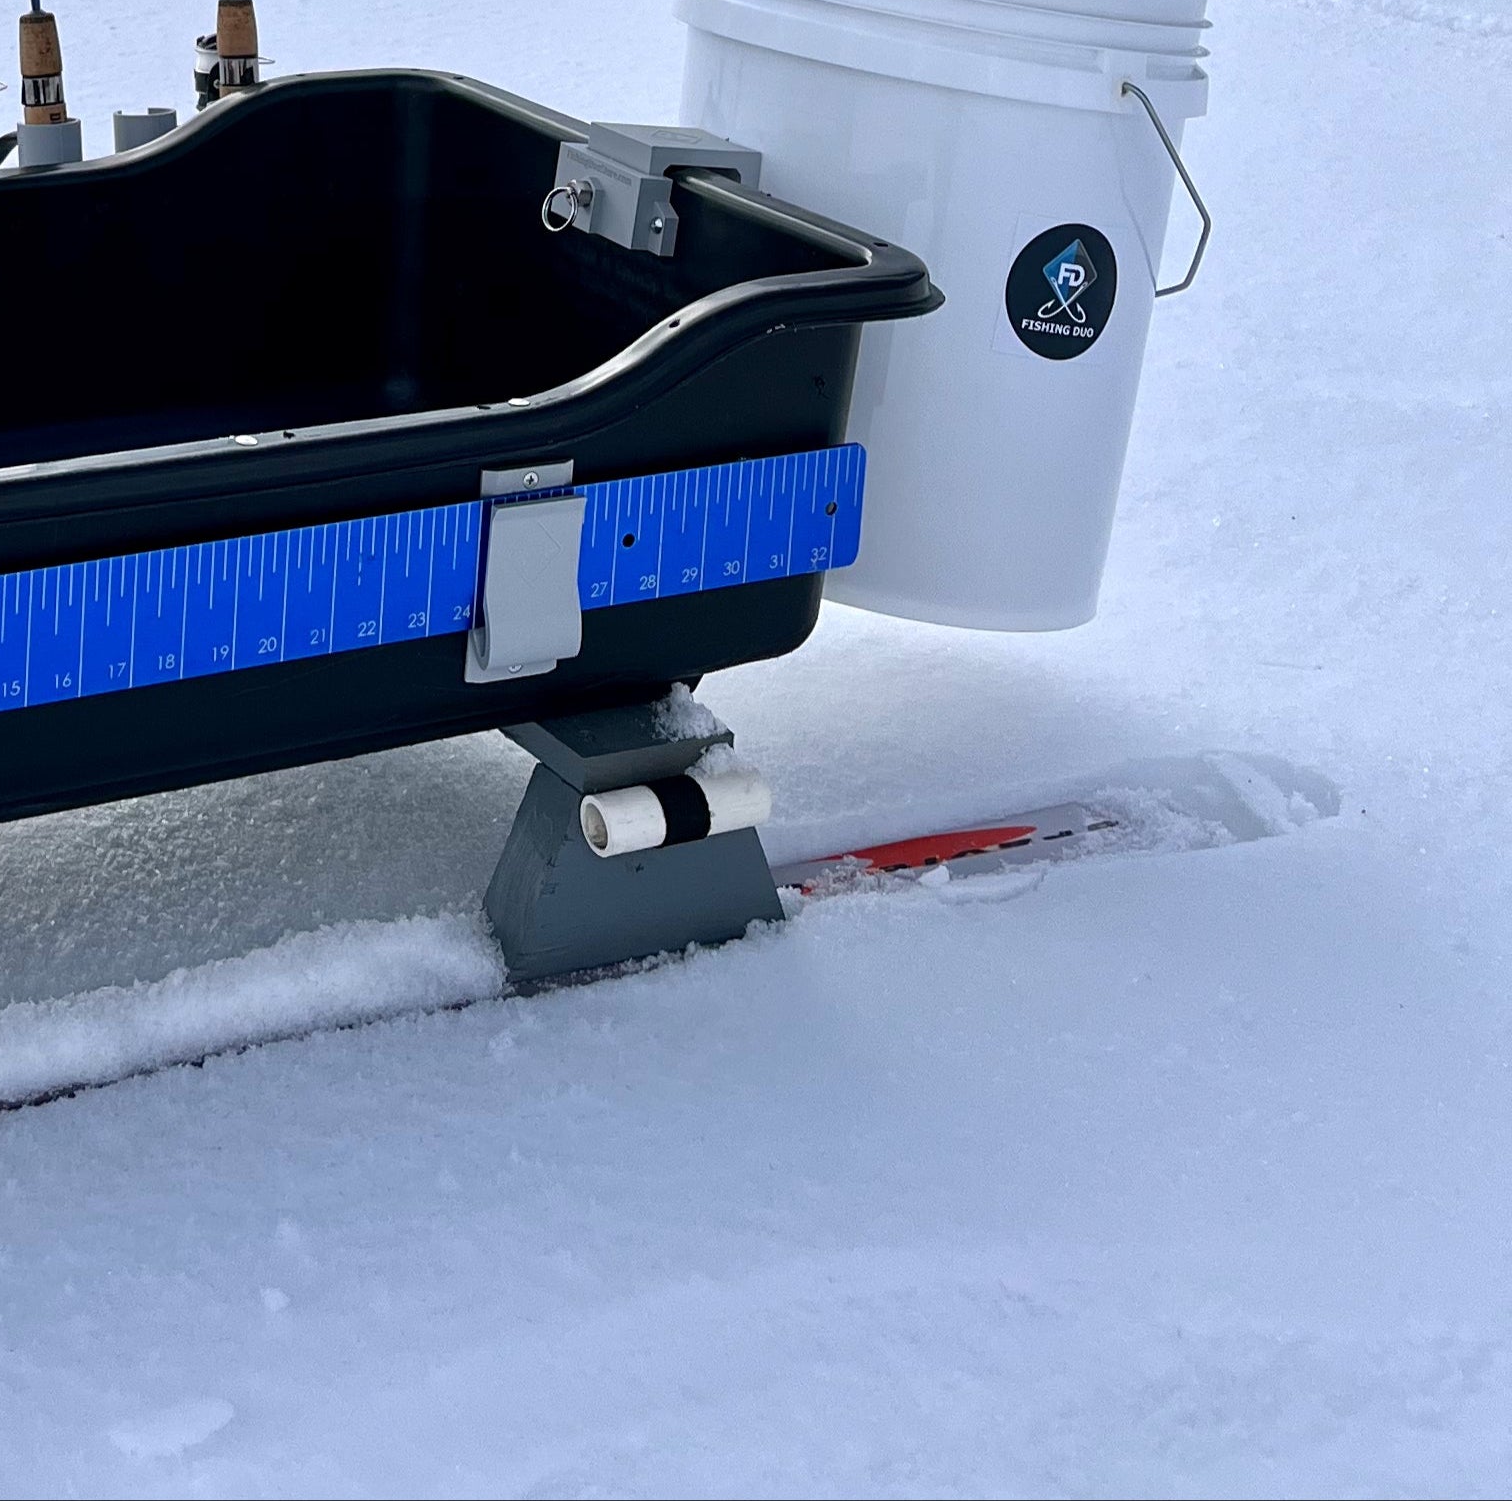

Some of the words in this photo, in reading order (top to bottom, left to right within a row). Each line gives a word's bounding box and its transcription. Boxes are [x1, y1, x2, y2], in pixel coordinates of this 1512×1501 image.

[1058, 263, 1085, 286] FD
[1021, 319, 1070, 336] FISHING
[1072, 327, 1094, 338] DUO
[3, 681, 20, 697] 15
[56, 673, 71, 688] 16
[110, 662, 126, 679] 17
[159, 654, 175, 670] 18
[214, 645, 229, 662] 19
[258, 637, 277, 654] 20
[311, 629, 325, 645] 21
[358, 621, 376, 637] 22
[408, 612, 425, 628] 23
[453, 605, 470, 620] 24
[591, 582, 608, 597] 27
[640, 575, 657, 592] 28
[682, 567, 698, 583] 29
[723, 561, 740, 576] 30
[770, 554, 783, 569] 31
[811, 547, 827, 564] 32
